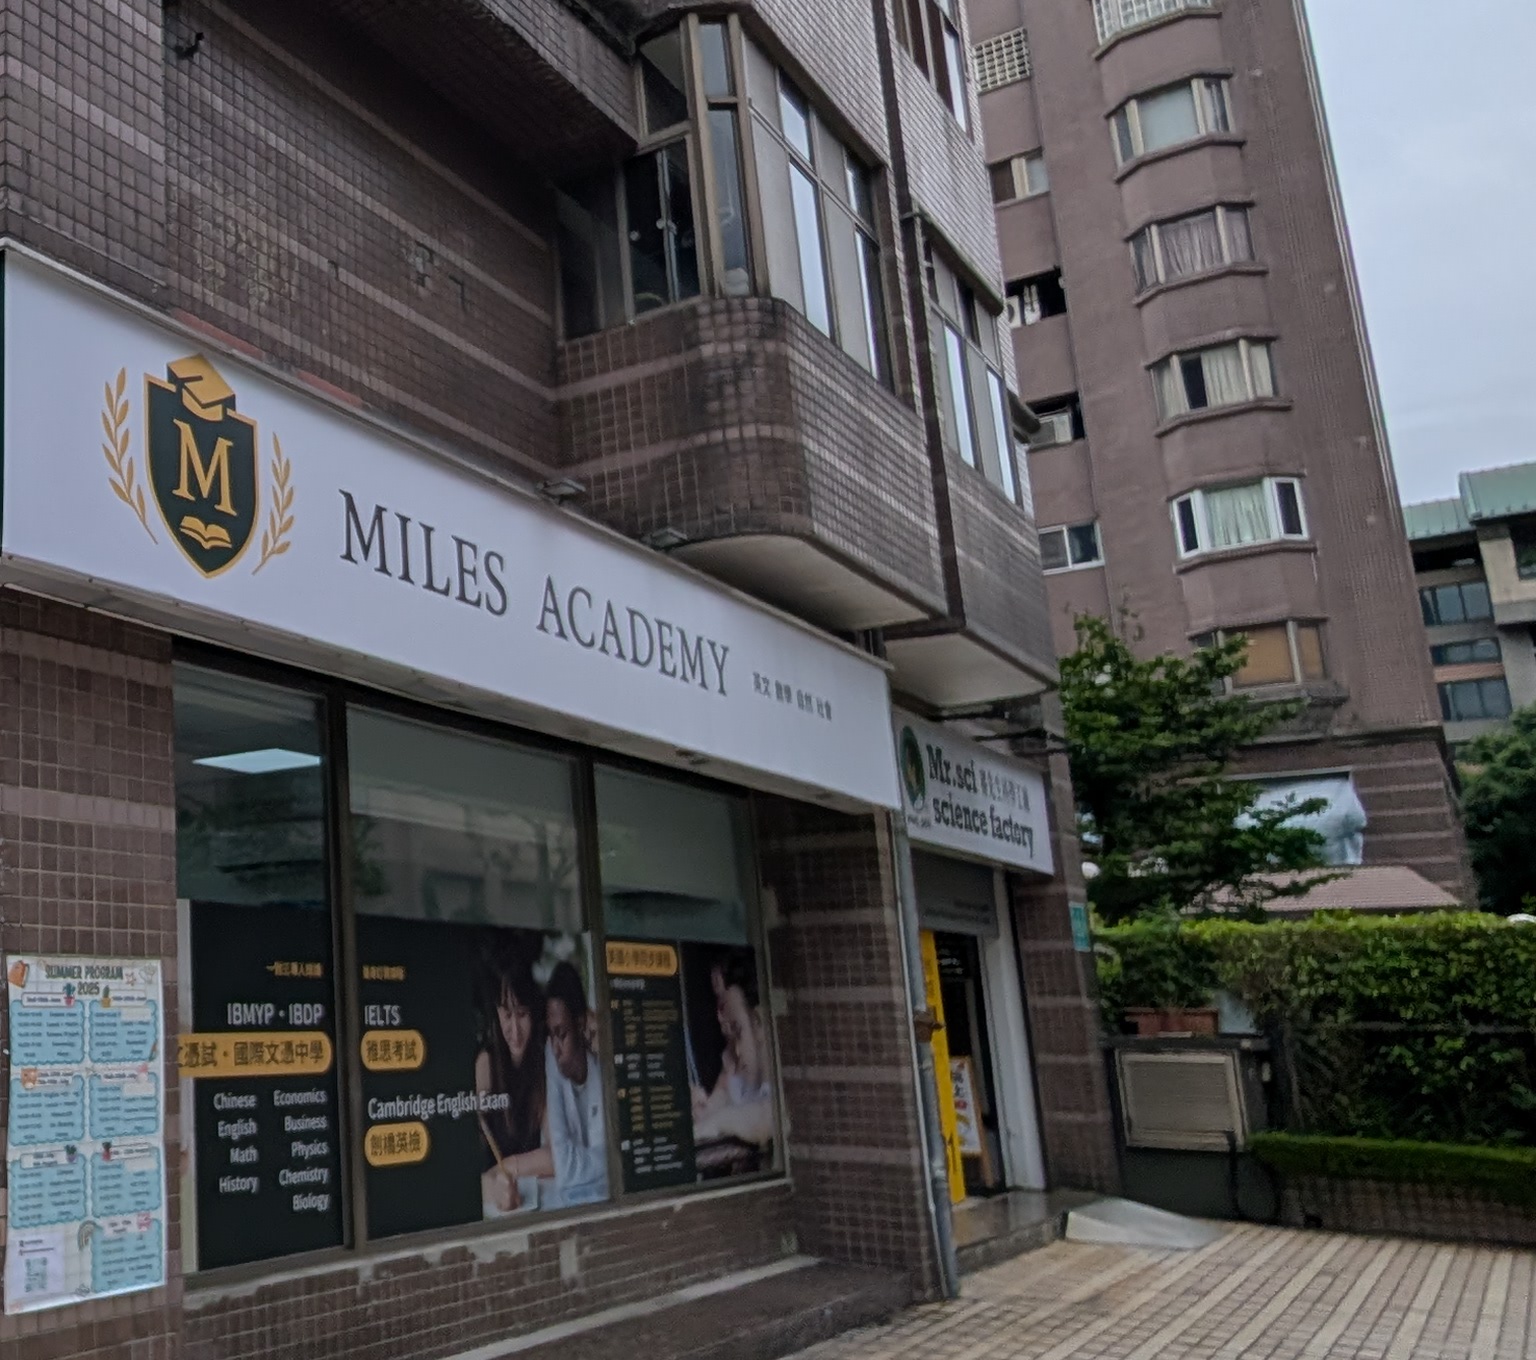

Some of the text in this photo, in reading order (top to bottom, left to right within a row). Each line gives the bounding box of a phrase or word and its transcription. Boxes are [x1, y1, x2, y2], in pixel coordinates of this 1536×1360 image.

[172, 419, 237, 516] M
[339, 489, 729, 697] MILES ACADEMY
[926, 744, 978, 793] Mr.sci
[933, 792, 1034, 860] science factory
[45, 964, 124, 980] SUMMER PROGRAM
[364, 1004, 401, 1026] IELTS
[213, 1092, 257, 1111] Chinese
[273, 1087, 327, 1107] Economics
[368, 1091, 509, 1120] Cambridge English Exam
[217, 1118, 257, 1139] English
[284, 1114, 328, 1133] Business
[230, 1144, 258, 1163] Math
[291, 1139, 329, 1160] Physics
[219, 1173, 259, 1194] History
[279, 1167, 329, 1188] Chemistry
[292, 1192, 330, 1212] Biology
